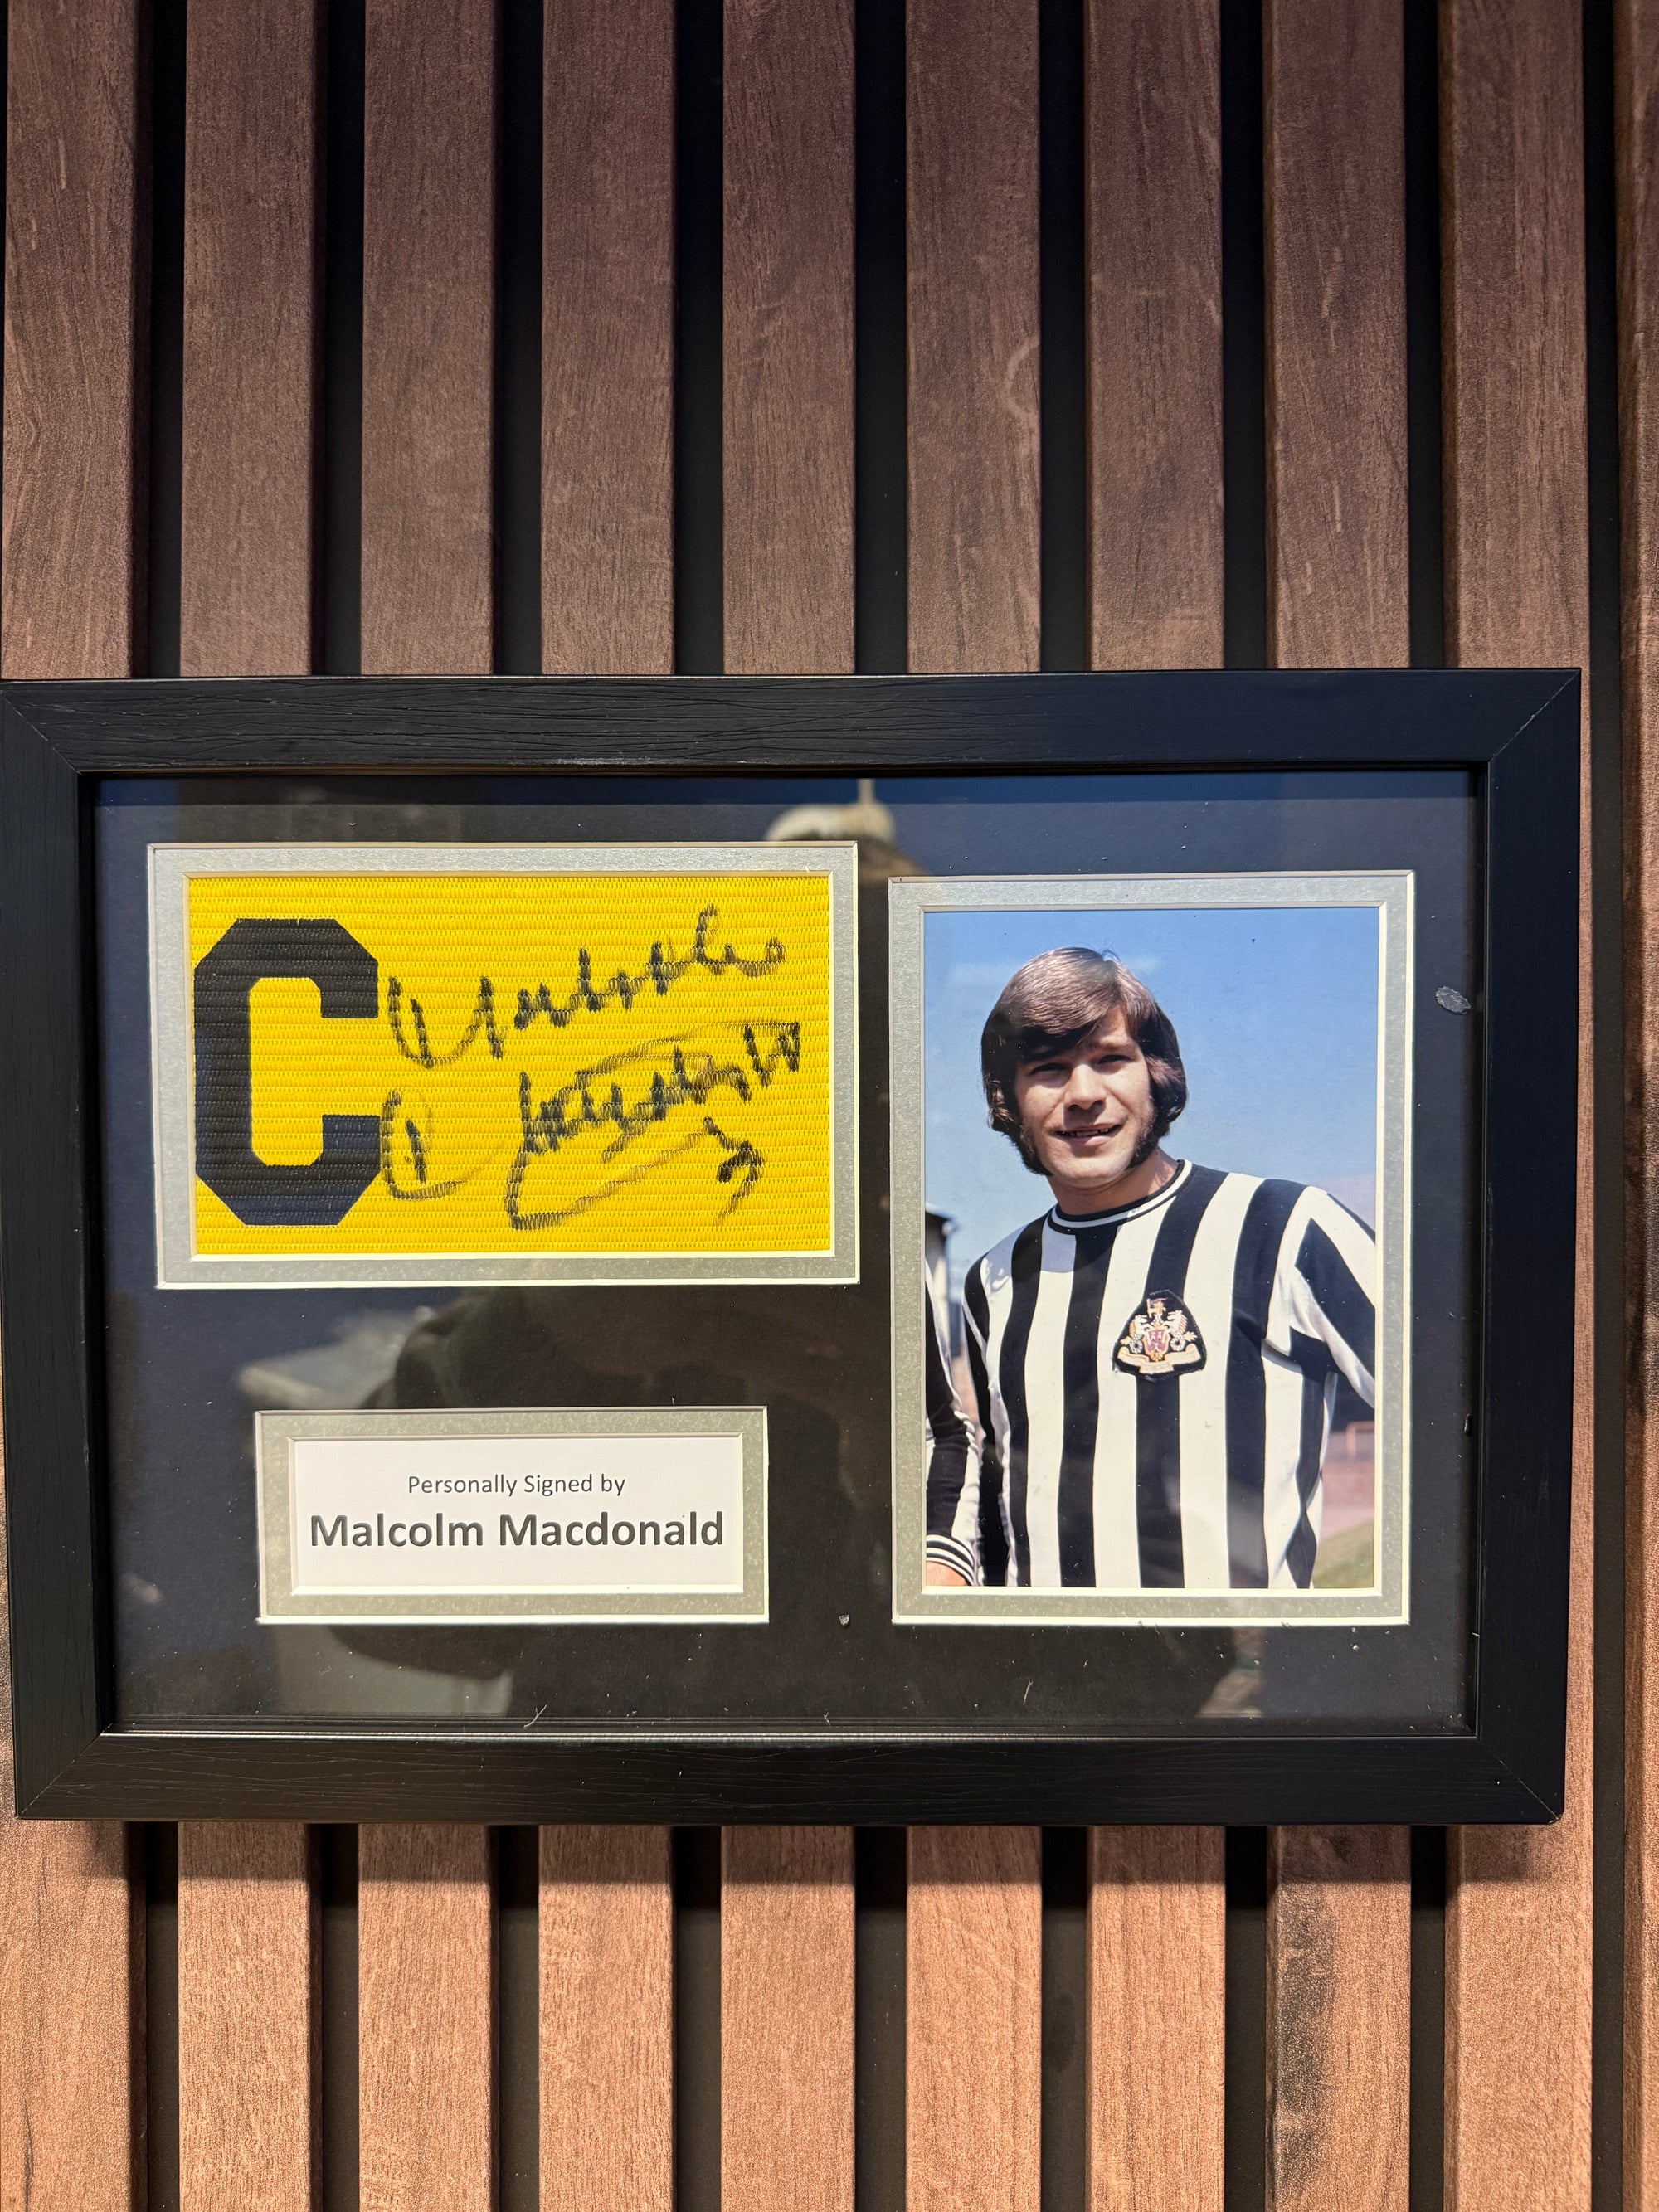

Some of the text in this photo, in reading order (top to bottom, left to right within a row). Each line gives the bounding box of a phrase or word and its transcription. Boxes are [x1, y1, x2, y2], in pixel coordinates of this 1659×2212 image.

[194, 918, 380, 1227] C
[409, 1473, 626, 1497] Personally Signed by
[310, 1510, 723, 1547] Malcolm Macdonald
